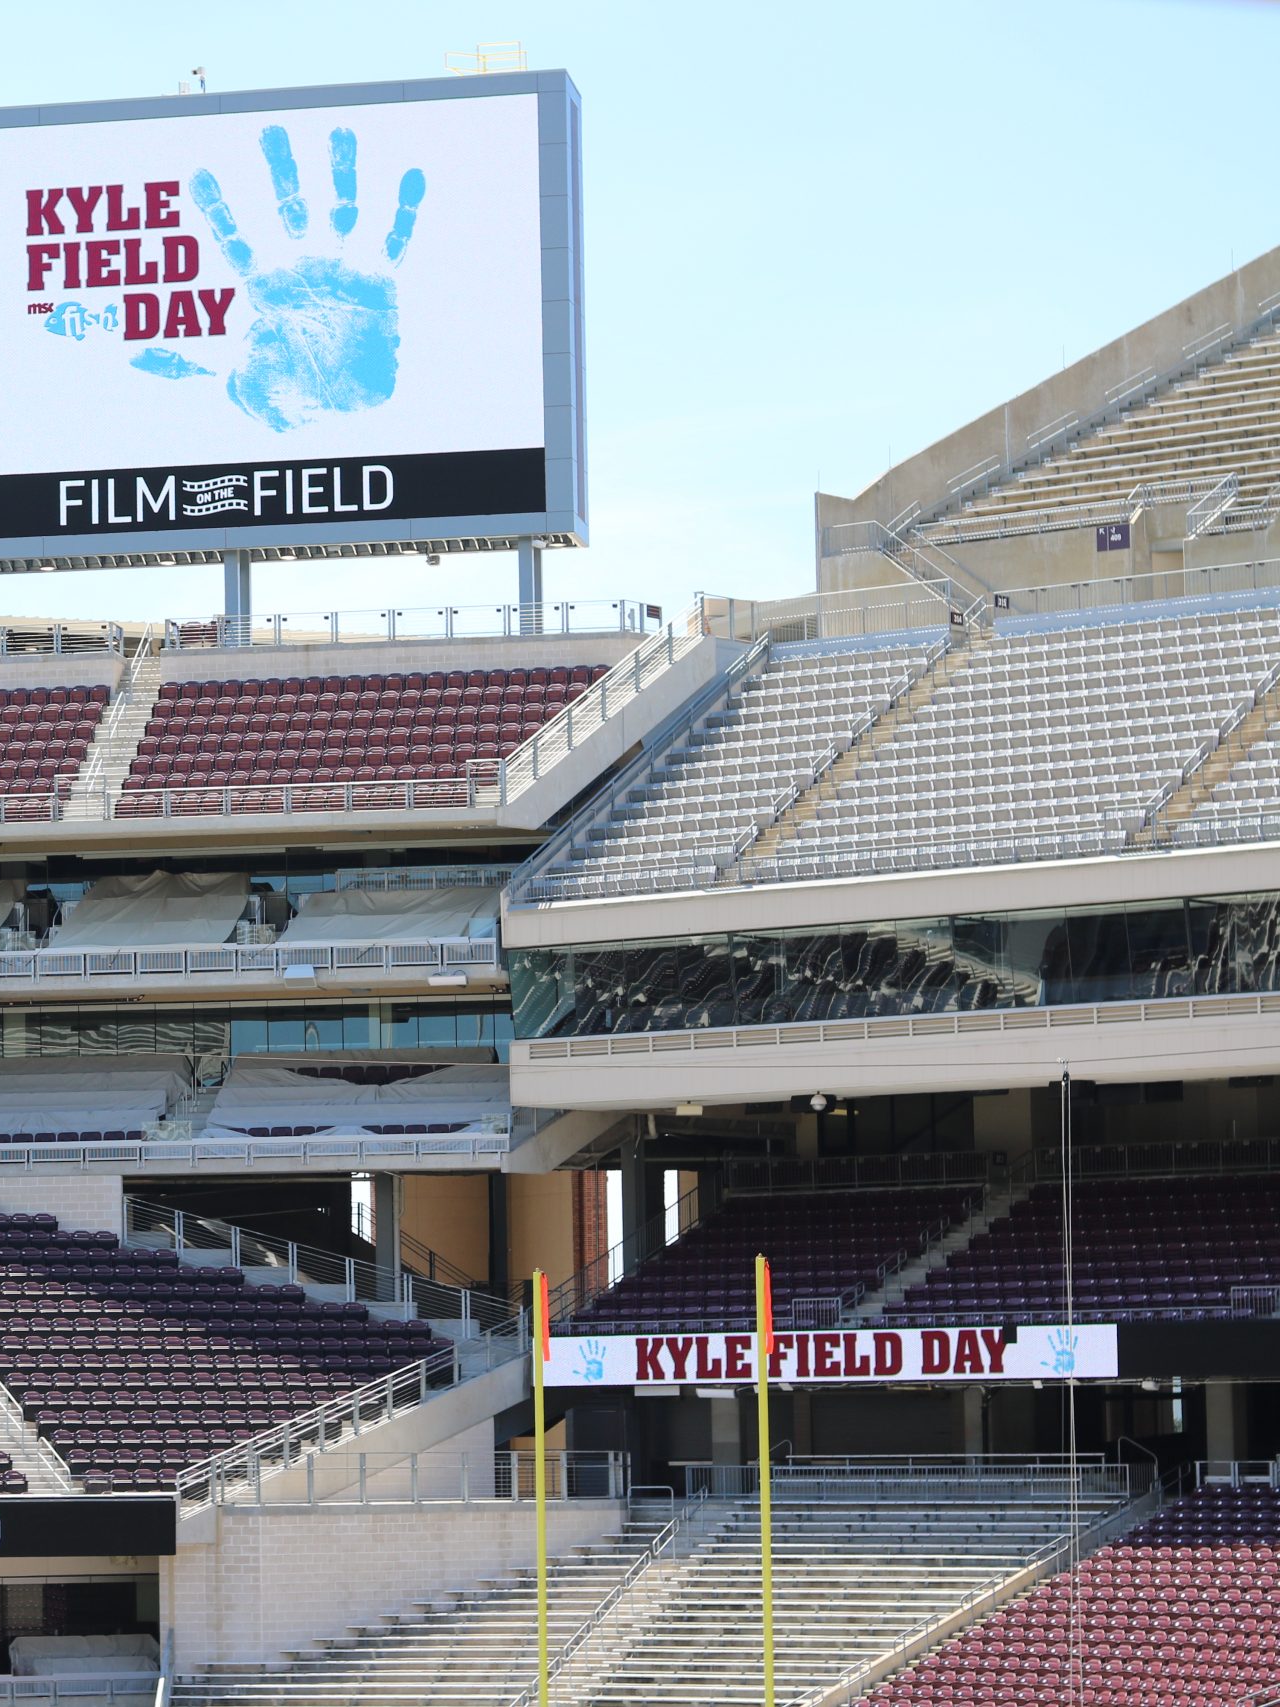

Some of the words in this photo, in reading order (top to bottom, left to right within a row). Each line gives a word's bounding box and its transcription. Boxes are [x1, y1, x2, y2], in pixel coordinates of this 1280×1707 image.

[26, 180, 180, 236] KYLE
[26, 235, 199, 291] FIELD
[123, 288, 235, 341] DAY
[59, 475, 176, 526] FILM
[196, 490, 212, 504] ON
[214, 487, 234, 501] THE
[253, 464, 394, 517] FIELD
[635, 1335, 752, 1380] KYLE
[768, 1331, 903, 1378] FIELD
[920, 1328, 1008, 1374] DAY
